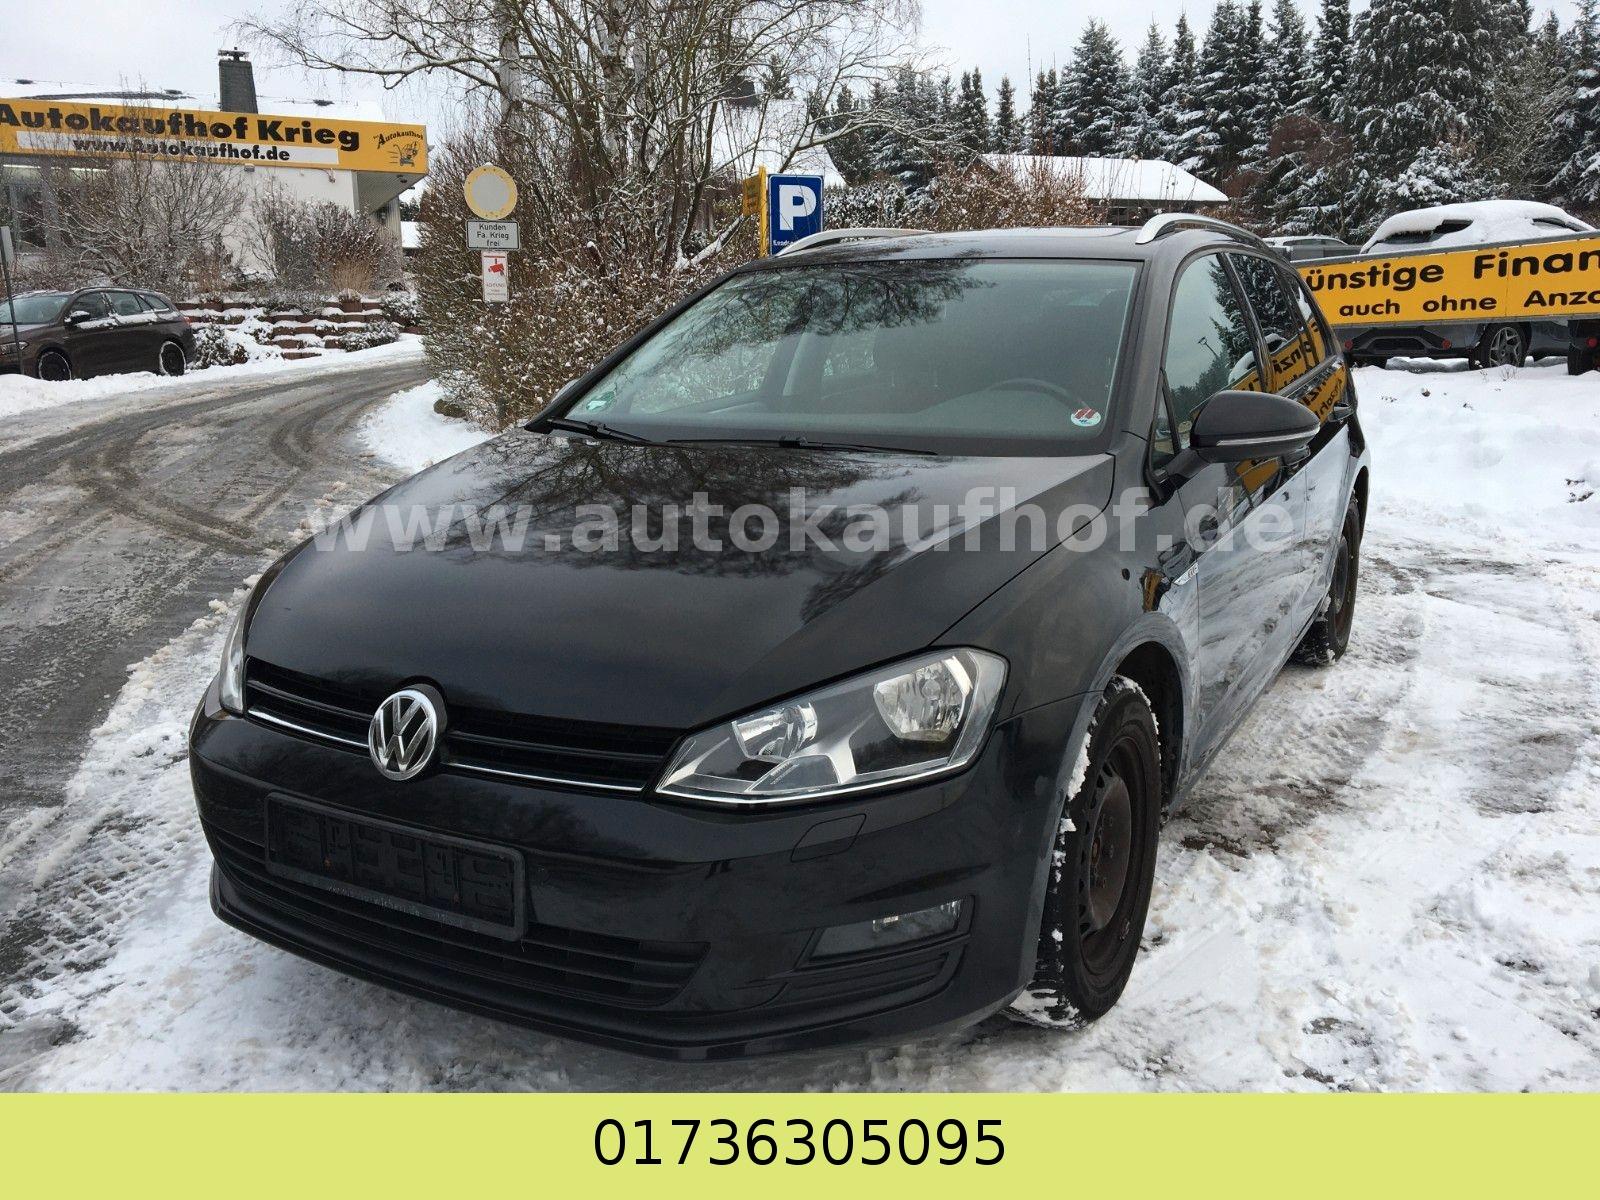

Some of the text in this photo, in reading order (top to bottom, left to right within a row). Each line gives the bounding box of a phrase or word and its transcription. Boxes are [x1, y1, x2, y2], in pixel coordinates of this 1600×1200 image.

[0, 104, 359, 152] Autokaufhof Krieg
[779, 185, 817, 230] P
[479, 223, 507, 231] Kunden
[490, 231, 509, 240] Krieg
[1339, 298, 1400, 317] auch
[1422, 294, 1497, 313] ohne
